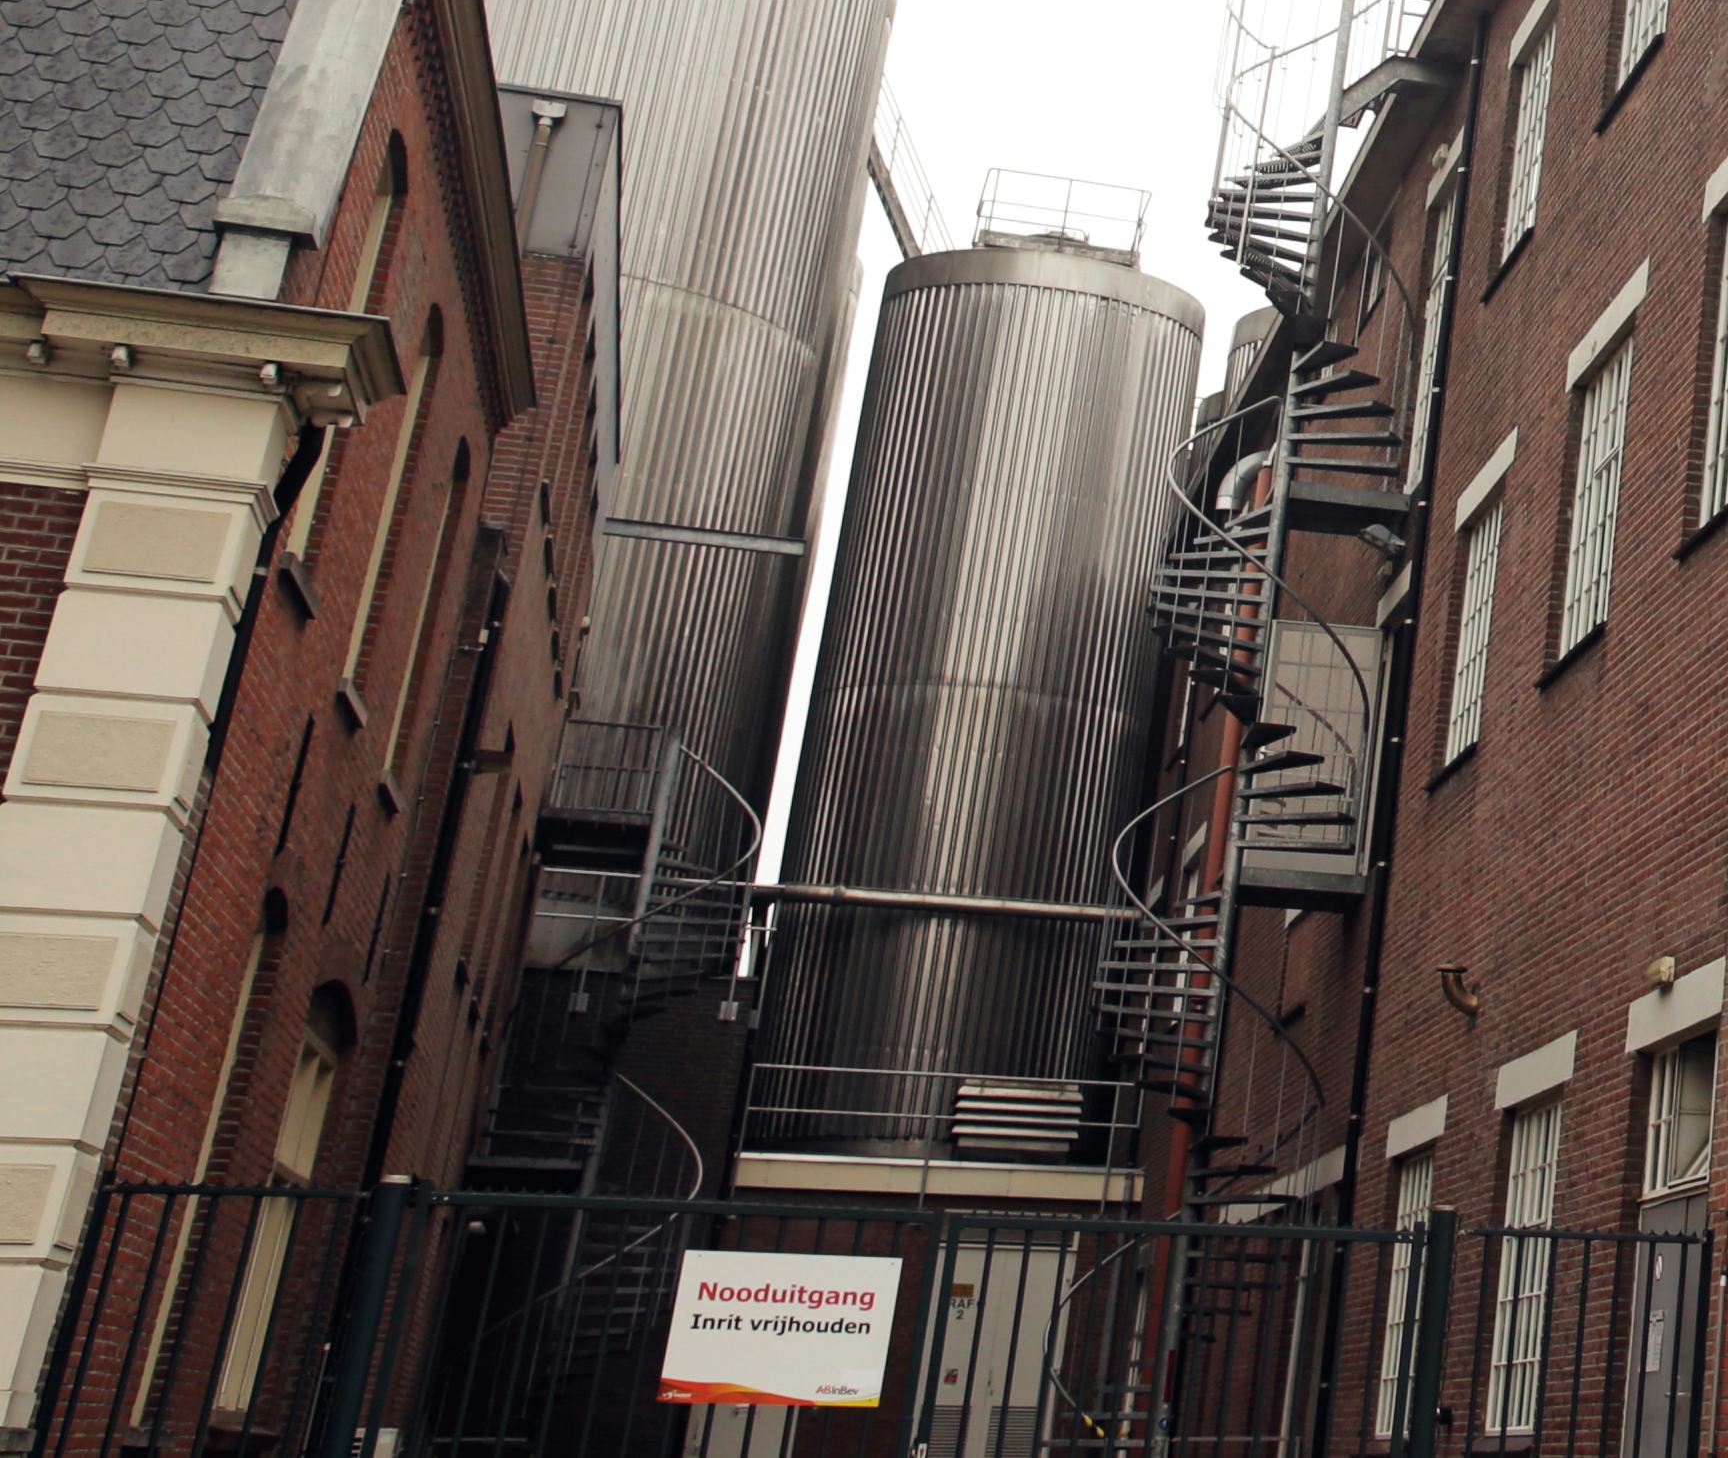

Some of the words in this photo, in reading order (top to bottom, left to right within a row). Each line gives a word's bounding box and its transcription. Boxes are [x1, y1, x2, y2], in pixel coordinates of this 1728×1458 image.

[697, 1281, 875, 1311] Nooduitgang
[690, 1313, 743, 1331] Inrit
[750, 1315, 871, 1336] vrijhouden
[956, 1310, 965, 1320] 2
